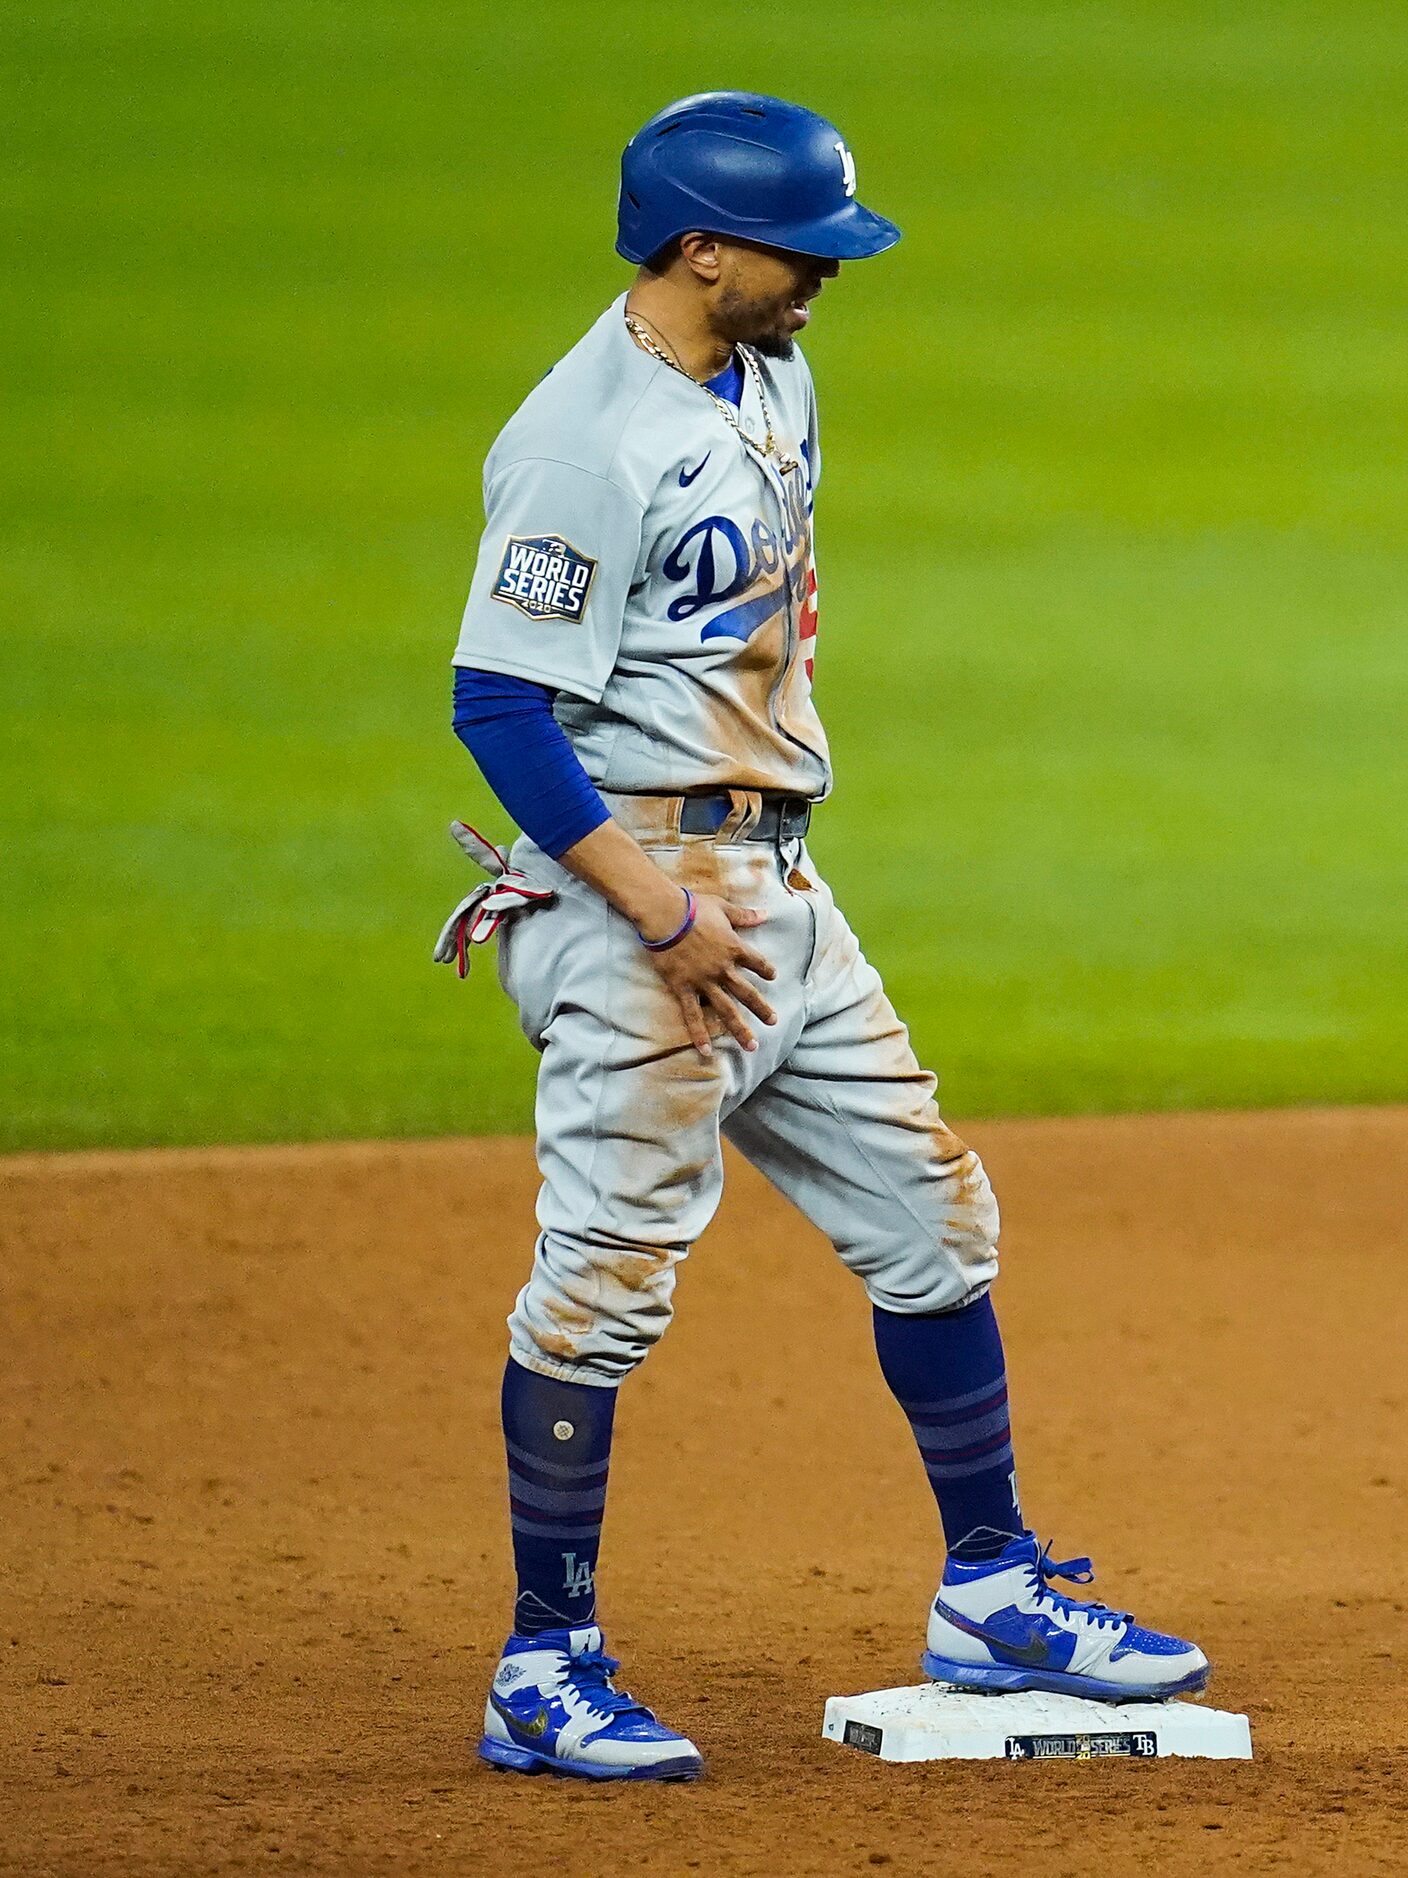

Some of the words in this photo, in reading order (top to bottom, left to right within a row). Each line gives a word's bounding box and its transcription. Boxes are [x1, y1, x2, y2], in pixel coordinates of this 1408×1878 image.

[509, 545, 589, 588] WORLD
[499, 568, 583, 612] SERIES
[521, 600, 551, 613] 2020
[561, 1552, 594, 1598] LA
[1006, 1737, 1025, 1761] LA
[1032, 1739, 1076, 1756] WORLD
[1132, 1734, 1154, 1756] TB
